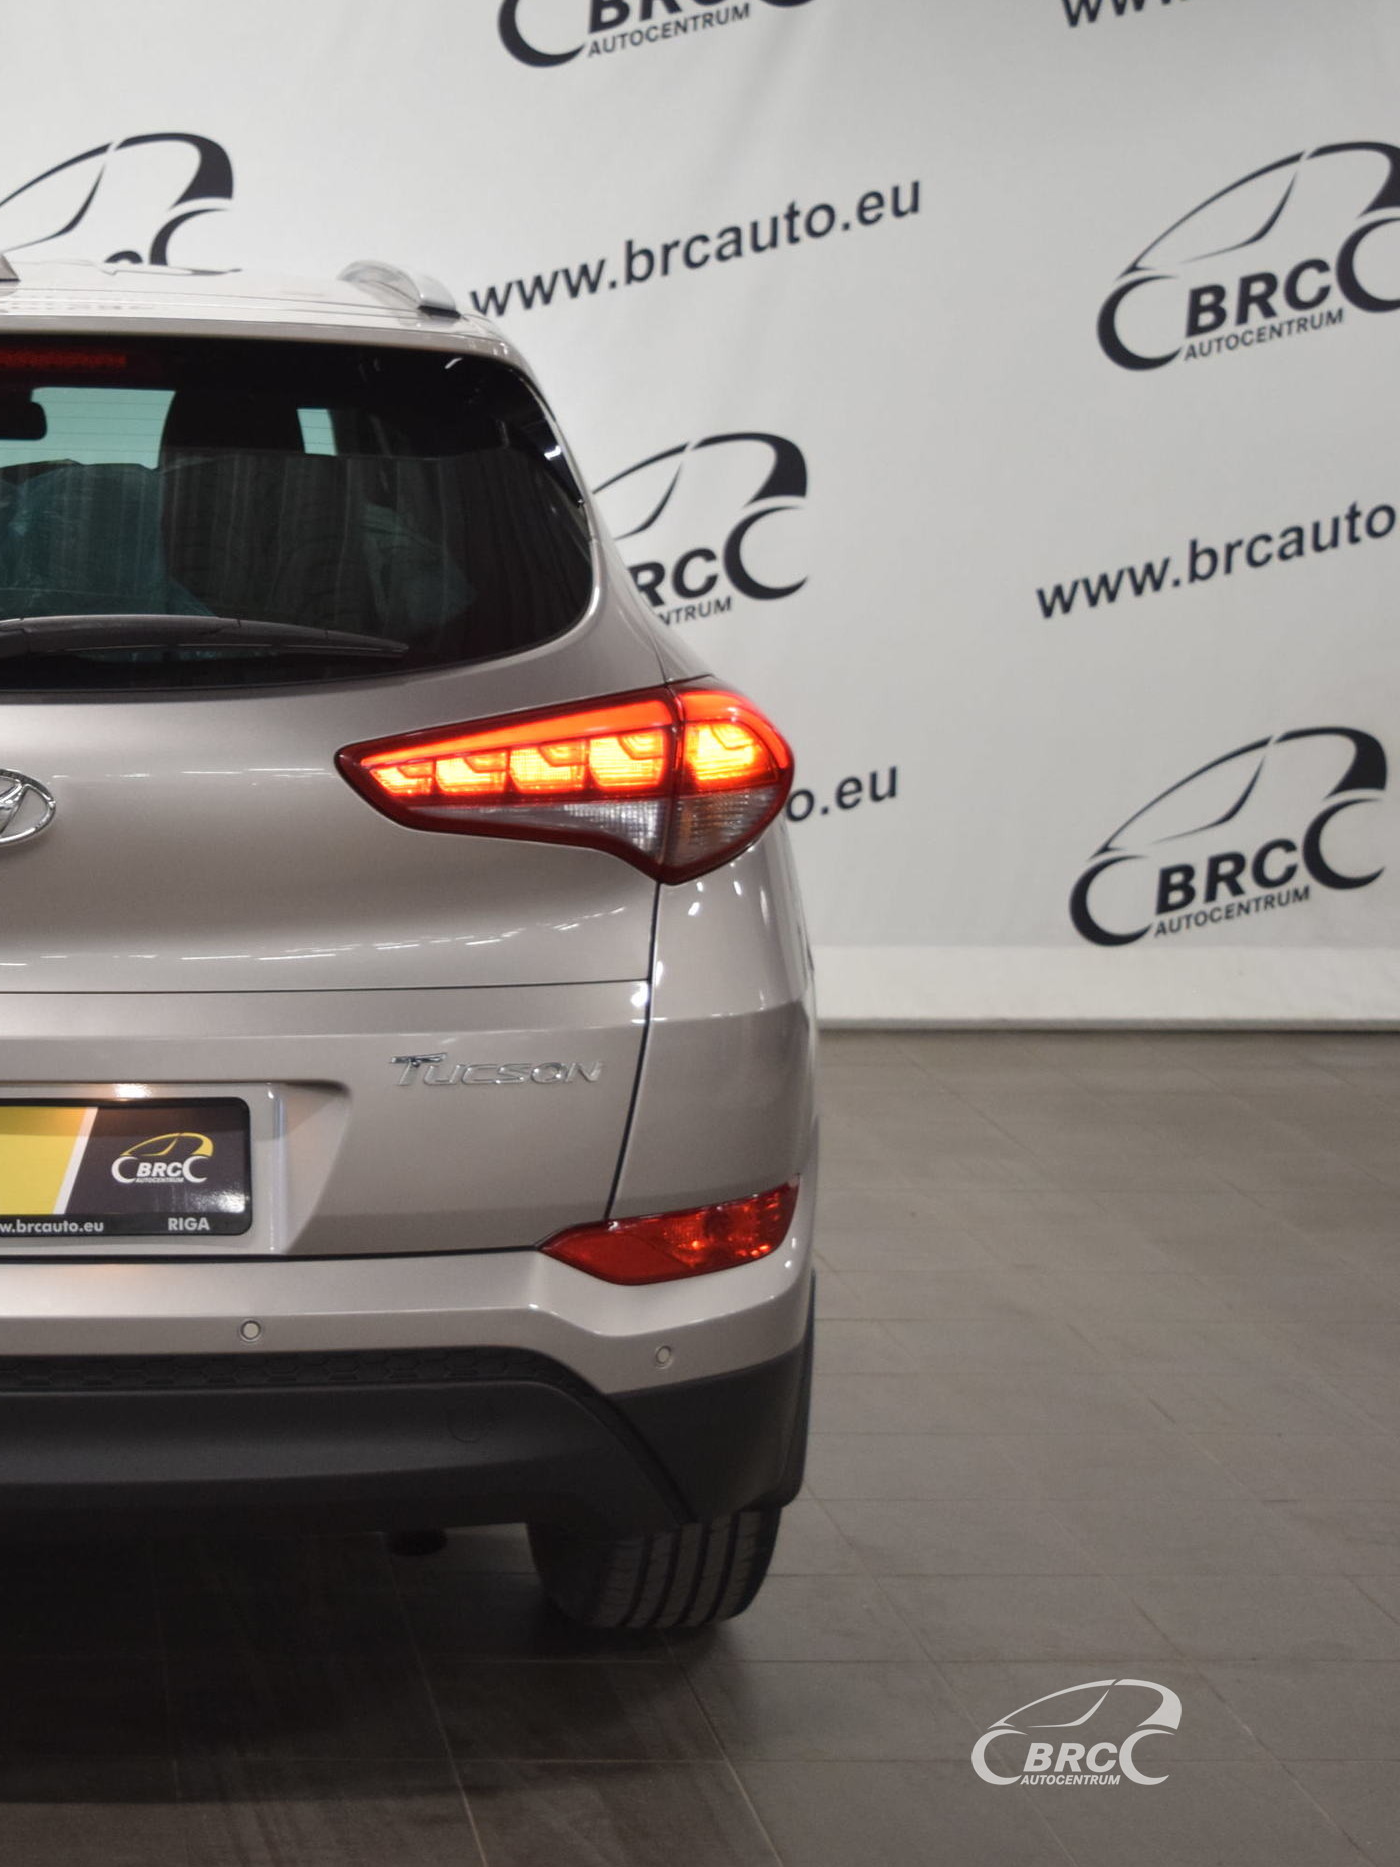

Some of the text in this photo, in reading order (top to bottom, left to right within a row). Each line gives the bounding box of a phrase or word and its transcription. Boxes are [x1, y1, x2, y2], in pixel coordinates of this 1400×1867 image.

[588, 2, 750, 57] AUTOCENTRUM
[470, 180, 921, 317] www.brcauto.eu
[1185, 258, 1332, 338] BRC
[1184, 307, 1344, 361] AUTOCENTRUM
[628, 547, 719, 607] RC
[1036, 502, 1397, 619] www.brcauto
[1155, 838, 1299, 916] BRC
[1154, 885, 1311, 937] AUTOCENTRUM
[136, 1161, 183, 1178] BRC
[167, 1217, 211, 1231] RIGA
